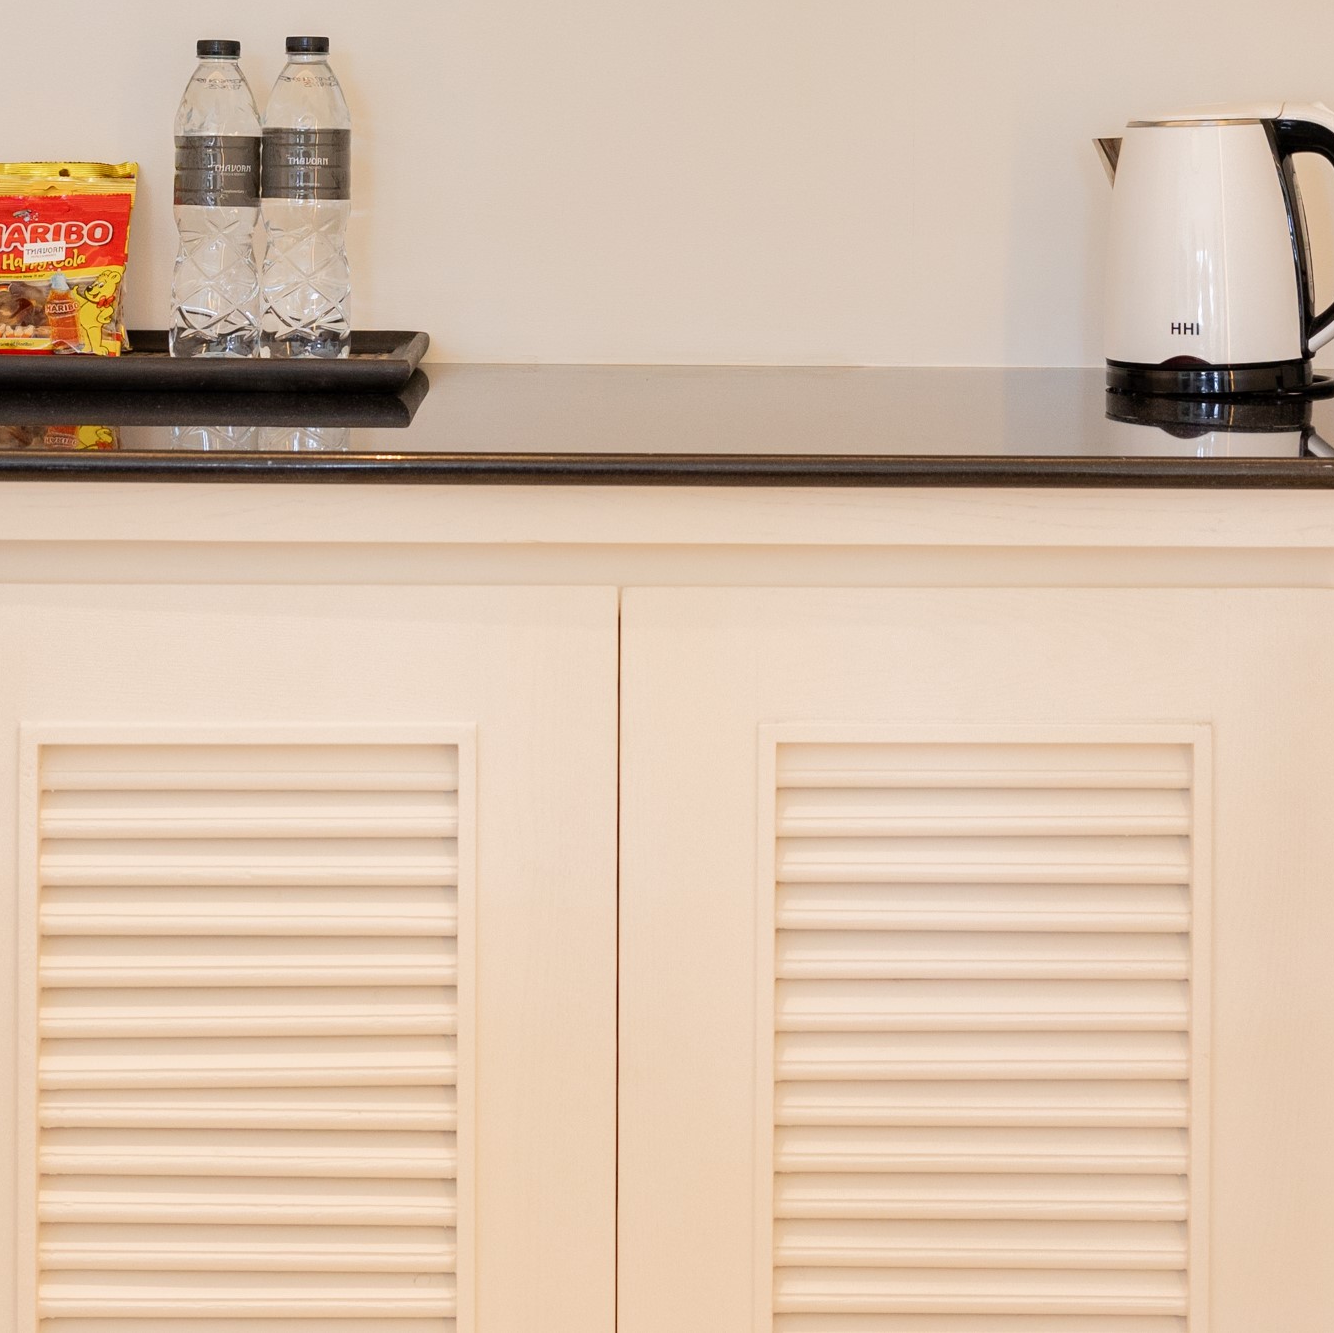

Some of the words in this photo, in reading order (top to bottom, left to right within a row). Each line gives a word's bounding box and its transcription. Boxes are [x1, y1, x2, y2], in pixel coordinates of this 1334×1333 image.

[288, 157, 329, 165] THAVORN
[25, 246, 64, 255] THAVORN
[46, 301, 80, 314] HARIBO
[1170, 322, 1200, 336] HHI
